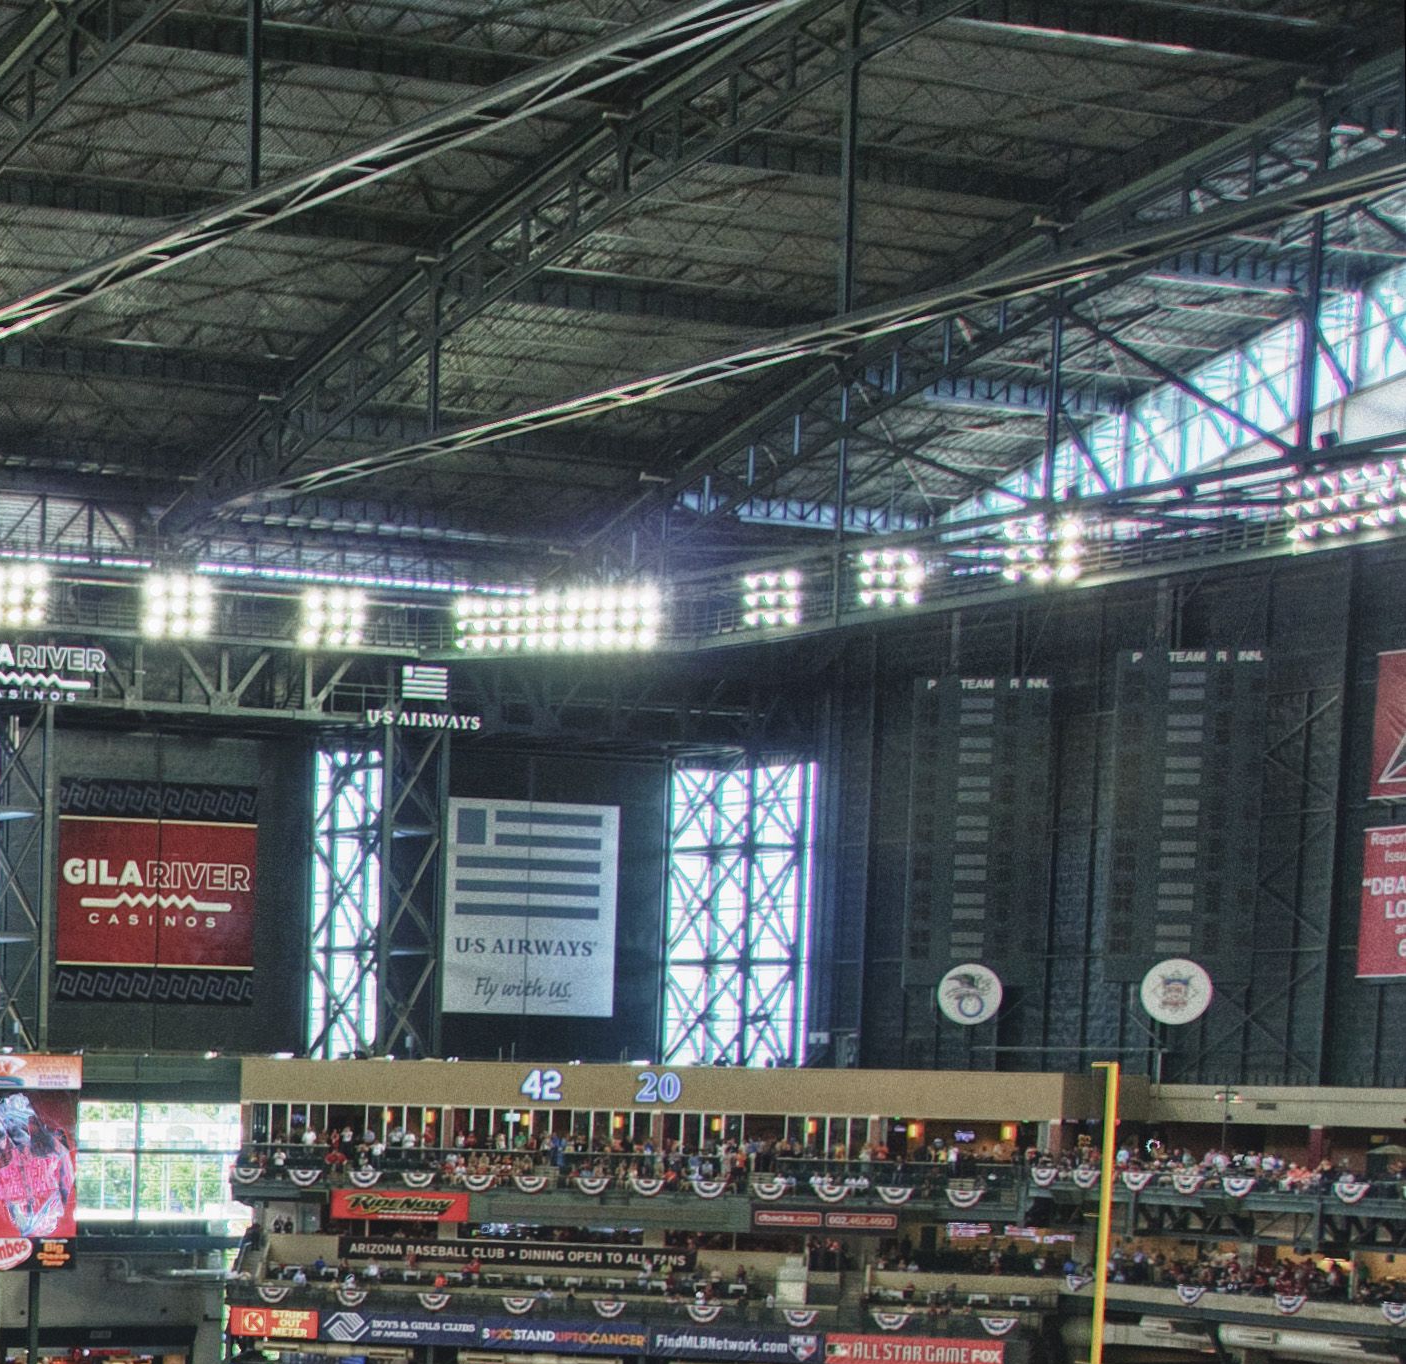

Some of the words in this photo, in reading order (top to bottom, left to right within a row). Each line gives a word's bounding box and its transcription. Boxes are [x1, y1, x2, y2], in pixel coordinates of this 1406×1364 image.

[17, 645, 106, 673] RIVER
[1168, 651, 1206, 663] TEAM
[960, 679, 995, 690] TEAM
[398, 712, 481, 731] AIRWAYS
[62, 857, 144, 887] GILA
[146, 861, 251, 892] RIVER
[88, 912, 217, 928] CASINOS
[492, 938, 594, 957] AIRWAYS
[502, 979, 547, 998] with
[520, 1069, 563, 1101] 42
[634, 1071, 682, 1104] 20
[349, 1242, 403, 1255] ARIZONA
[406, 1244, 469, 1258] BASEBALL
[472, 1246, 505, 1259] CLUB
[519, 1248, 564, 1262] DINING
[567, 1250, 603, 1264] OPEN
[606, 1252, 623, 1264] TO
[271, 1310, 311, 1320] STRIKE
[278, 1319, 302, 1328] OUT
[271, 1328, 308, 1338] METER
[372, 1320, 400, 1330] BOYS
[401, 1321, 410, 1330] &
[411, 1321, 440, 1331] GIRLS
[442, 1322, 476, 1333] CLUBS
[383, 1330, 419, 1339] AMERICA
[655, 1334, 788, 1354] FindMLBNetwork.com
[852, 1341, 882, 1360] ALL
[882, 1342, 923, 1362] STAR
[924, 1343, 969, 1364] GAME
[970, 1349, 1001, 1364] FOX
